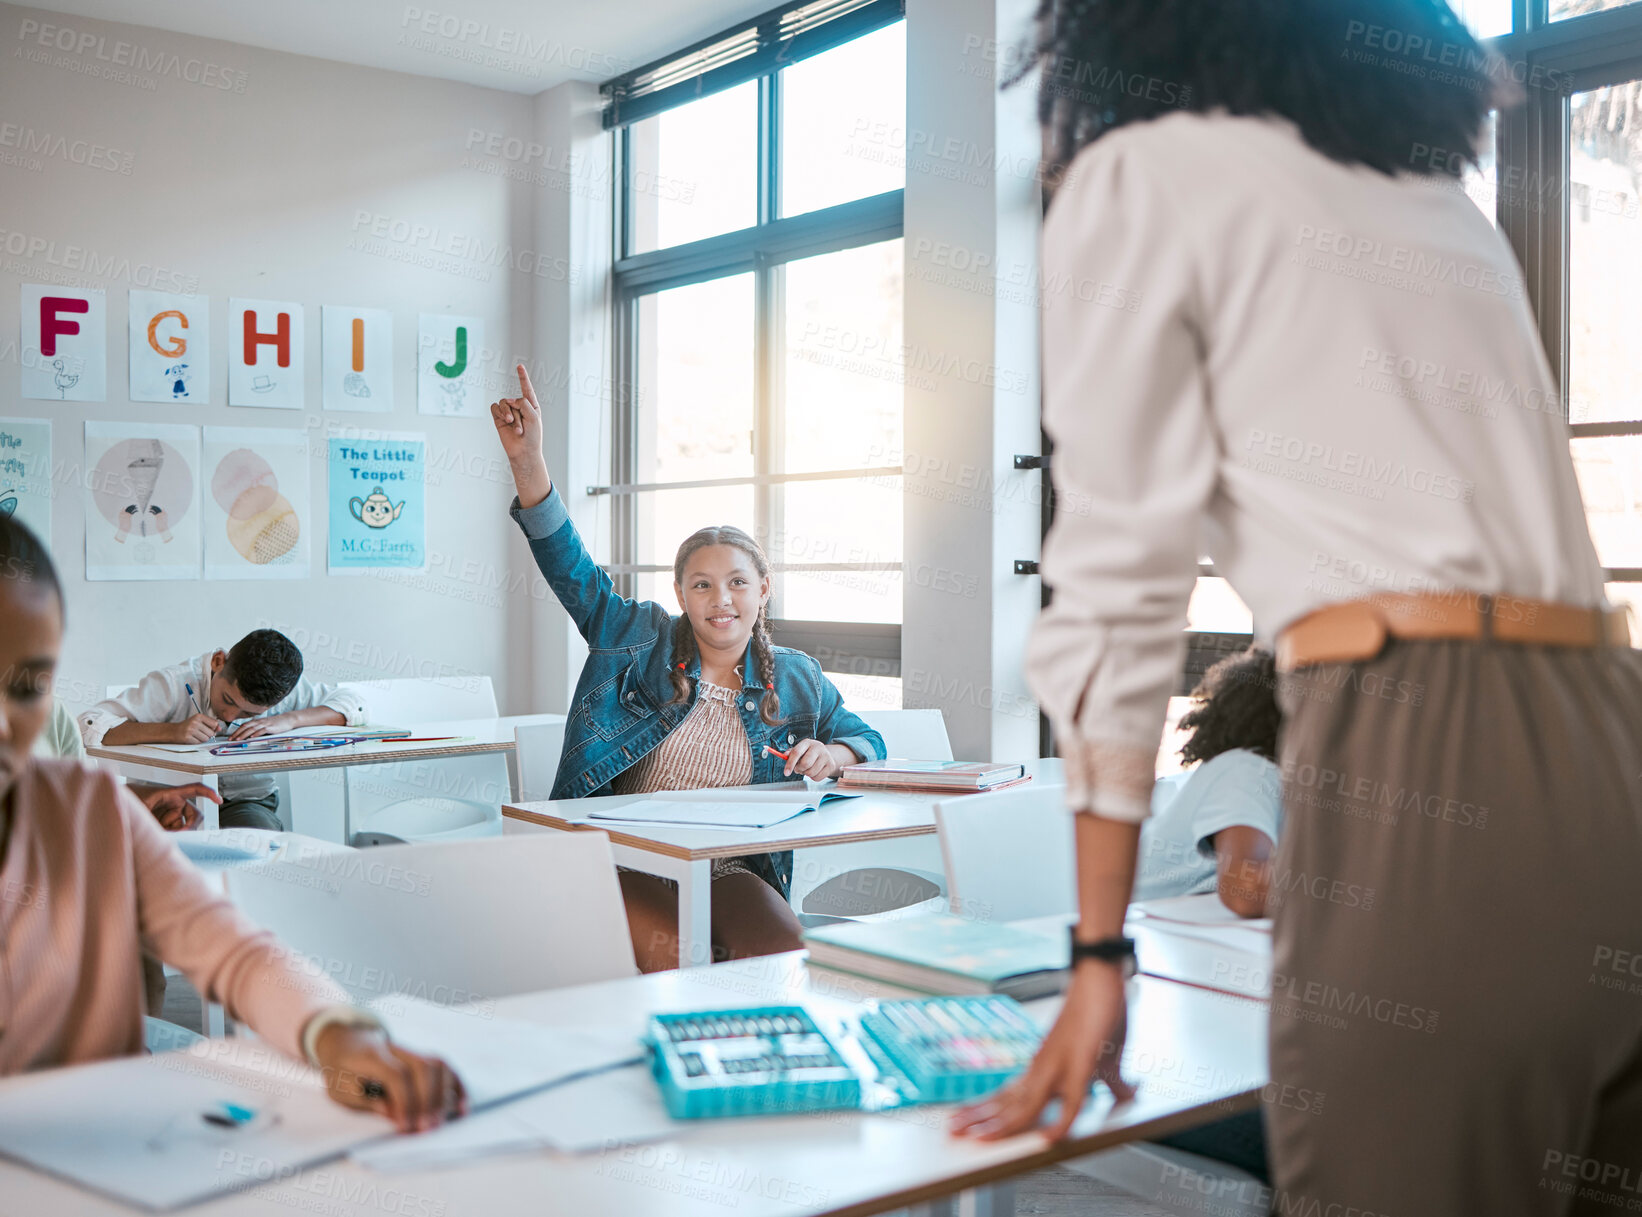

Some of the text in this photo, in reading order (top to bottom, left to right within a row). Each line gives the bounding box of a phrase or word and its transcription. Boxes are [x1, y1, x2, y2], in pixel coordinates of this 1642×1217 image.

[40, 297, 89, 357] F
[147, 310, 189, 358] G
[243, 310, 290, 368] H
[352, 318, 364, 373] I
[435, 326, 468, 379] J
[340, 448, 415, 461] The Little
[350, 468, 406, 483] Teapot
[341, 538, 376, 552] M.G.
